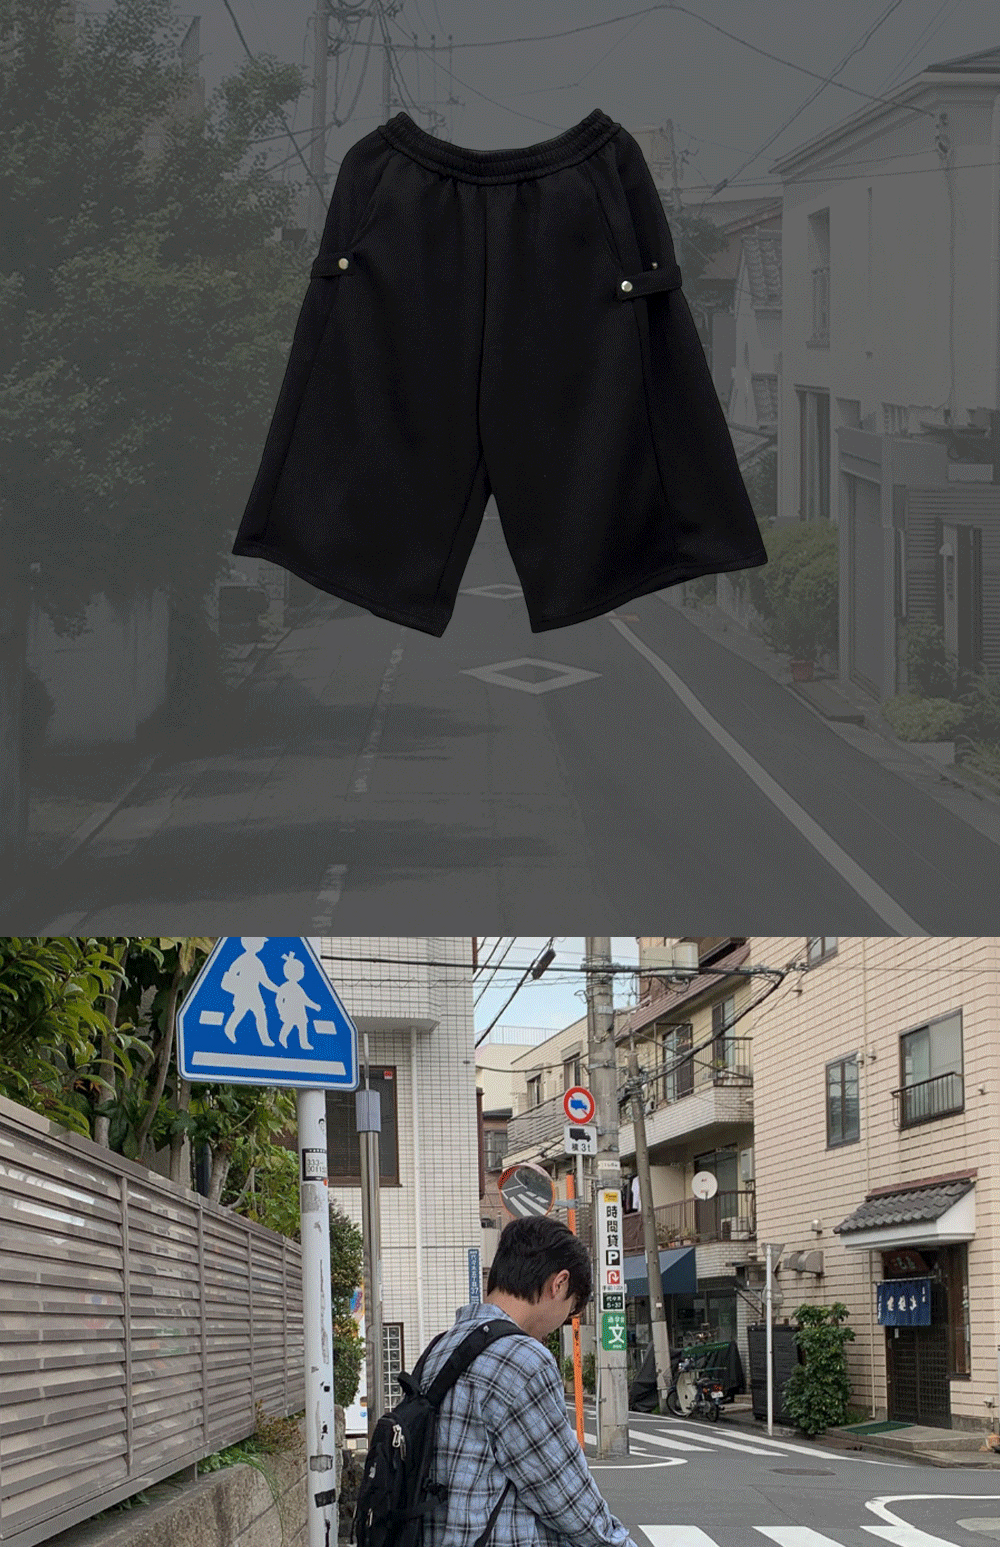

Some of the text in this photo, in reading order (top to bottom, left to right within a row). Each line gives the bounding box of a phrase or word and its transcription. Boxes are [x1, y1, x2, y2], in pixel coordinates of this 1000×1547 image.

[606, 1205, 618, 1247] 時間貸
[607, 1250, 619, 1265] P
